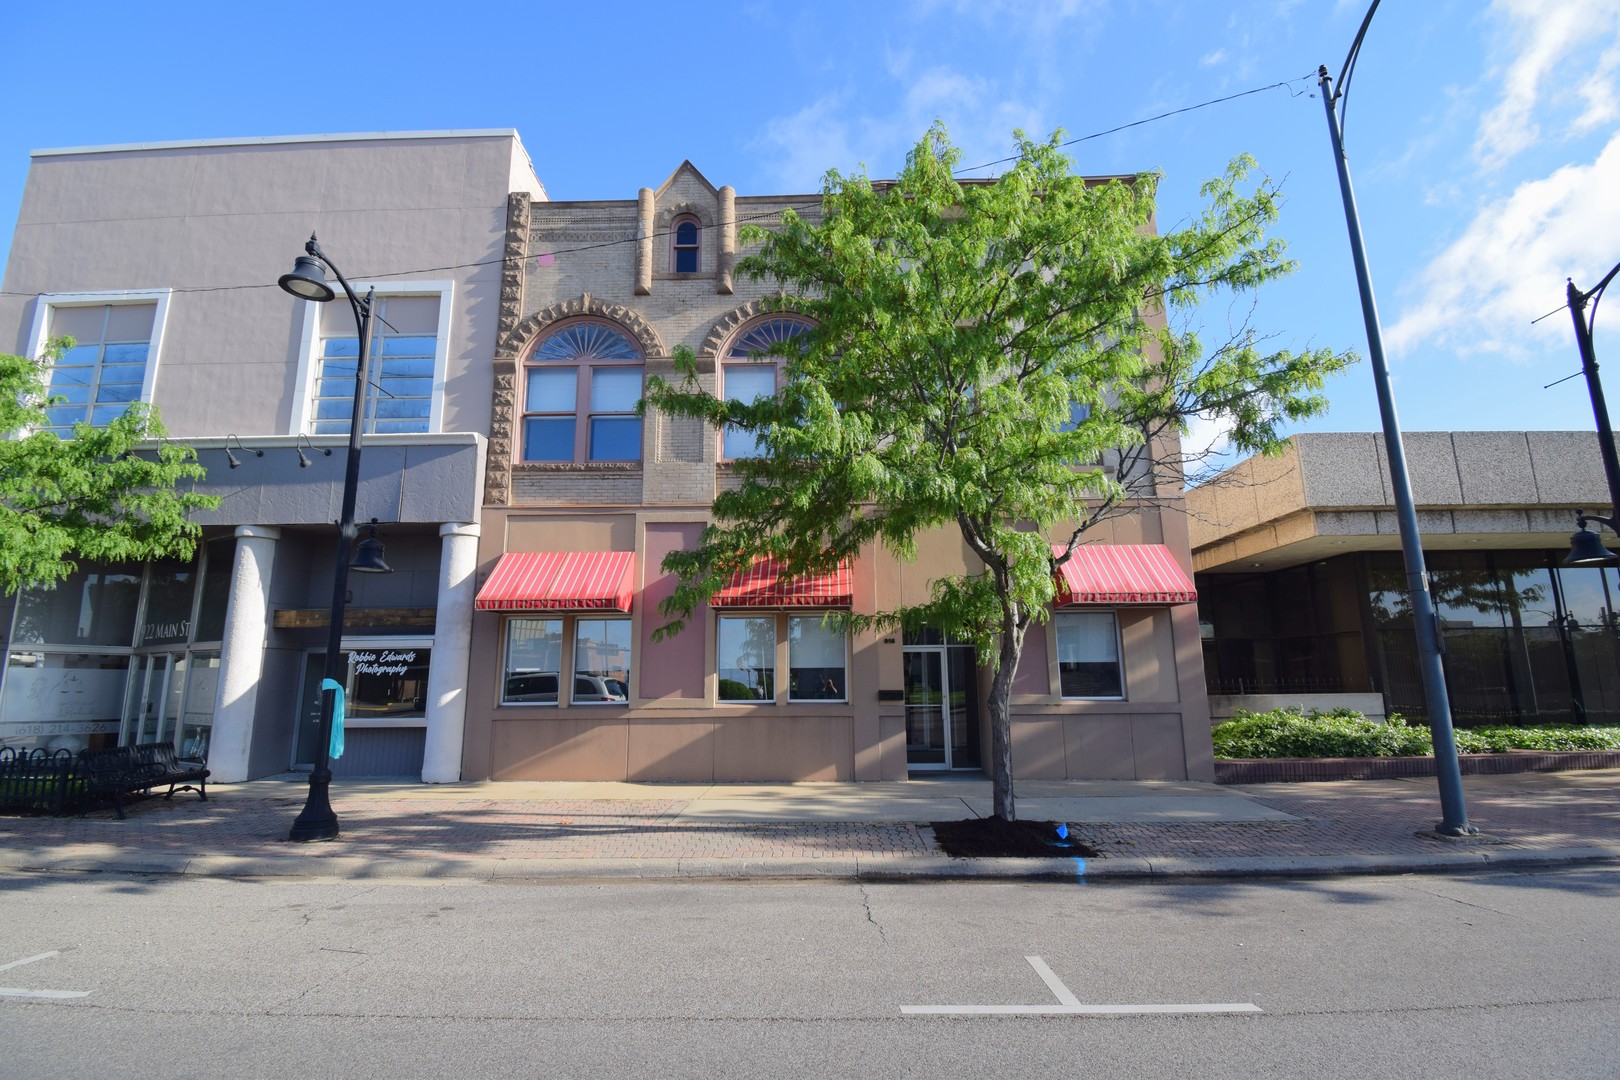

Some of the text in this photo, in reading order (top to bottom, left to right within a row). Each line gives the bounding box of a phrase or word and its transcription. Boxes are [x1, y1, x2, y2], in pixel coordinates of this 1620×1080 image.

[155, 623, 179, 639] MAIN
[379, 650, 416, 663] Edwards
[355, 662, 408, 676] Photography
[15, 723, 107, 735] (618) 214-3626
